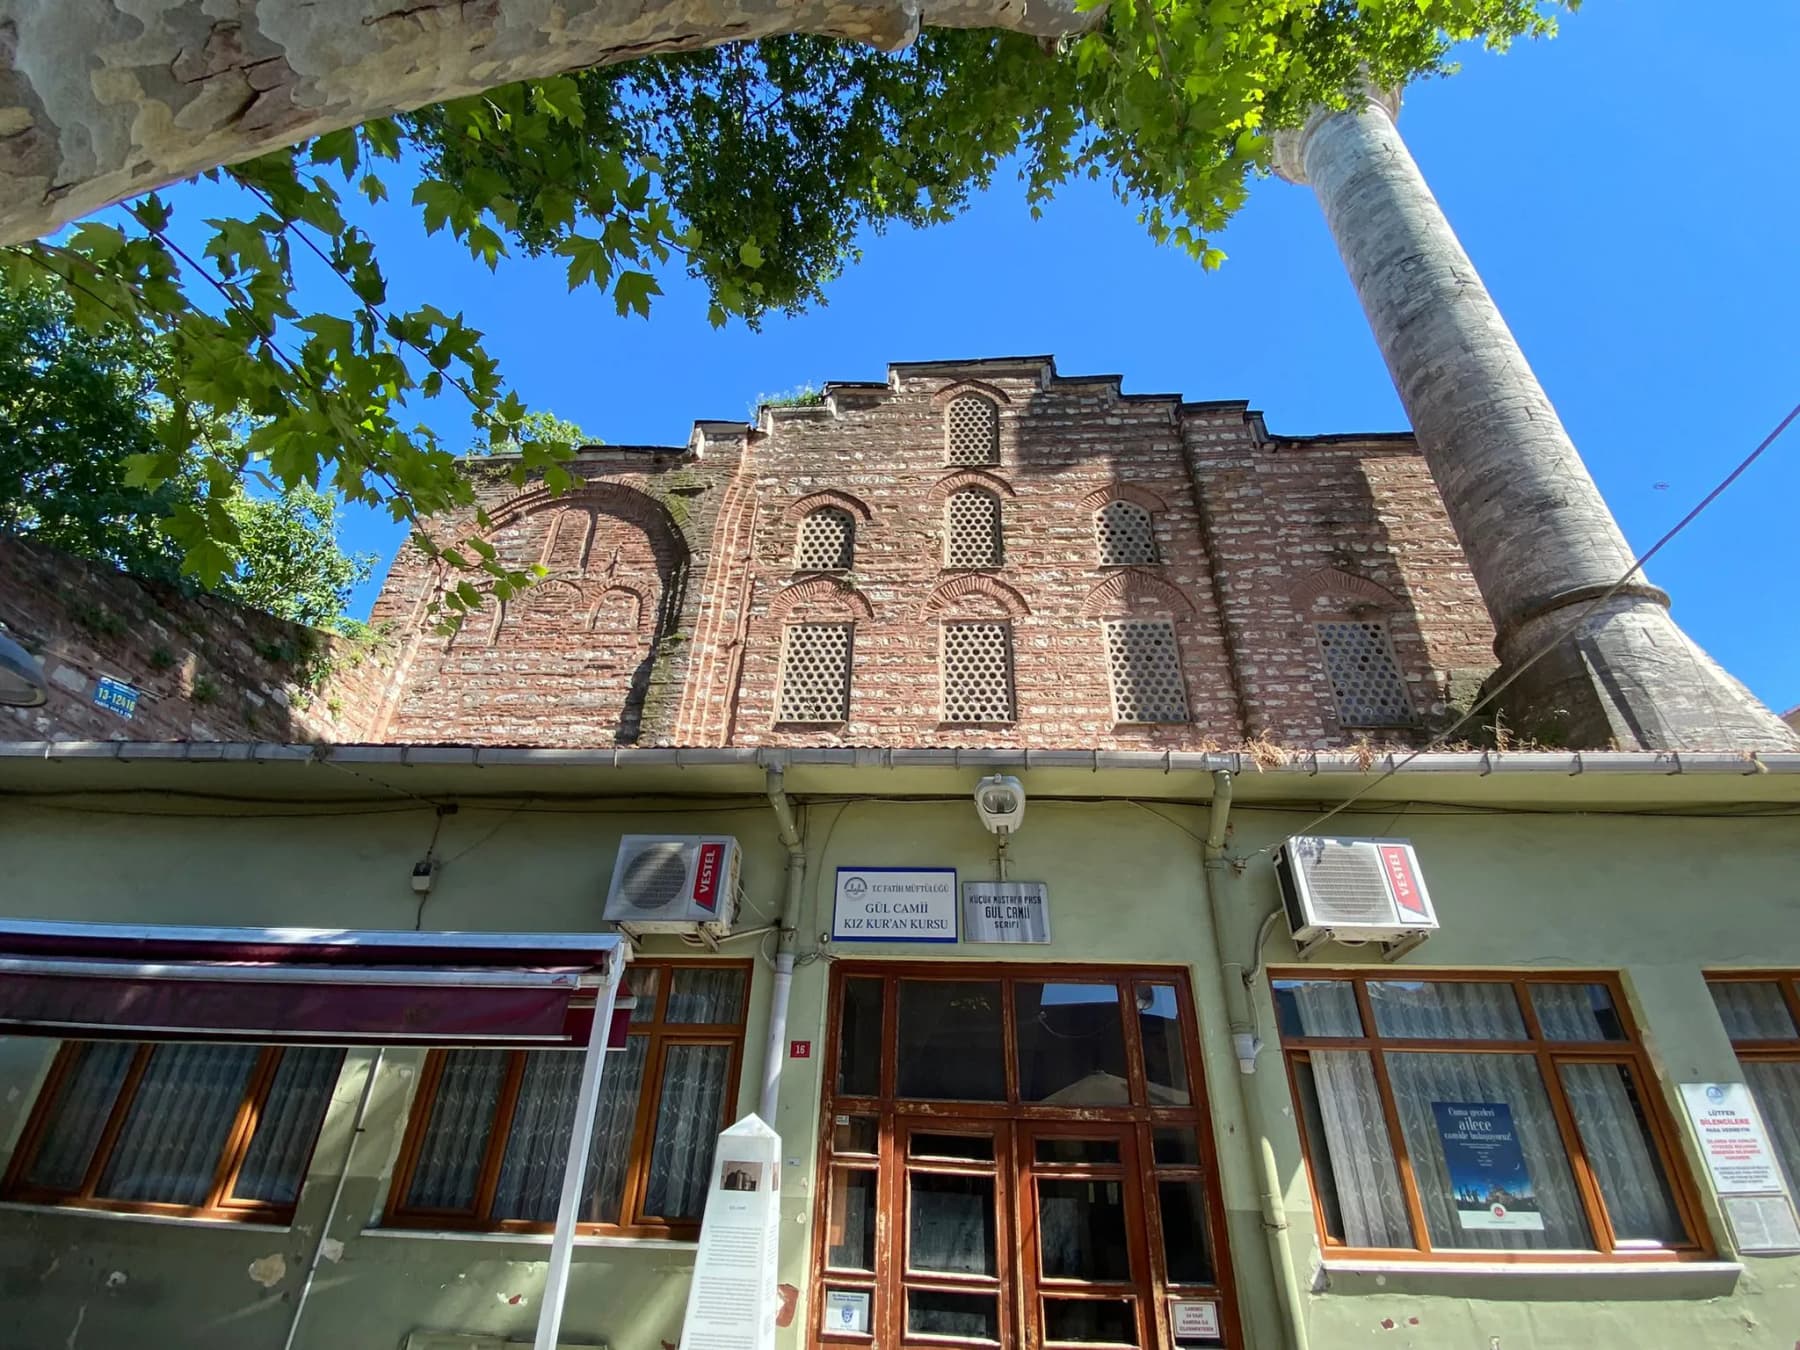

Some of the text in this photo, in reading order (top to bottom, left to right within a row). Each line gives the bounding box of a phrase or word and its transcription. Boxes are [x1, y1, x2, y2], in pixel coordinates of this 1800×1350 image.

[698, 850, 716, 894] VESTEL
[1388, 852, 1410, 897] VESTEL
[865, 901, 928, 914] GÜL CAMİİ
[844, 918, 949, 930] KIZ KUR'AN KURSU
[796, 1044, 806, 1054] 16
[1458, 1116, 1492, 1131] ailece
